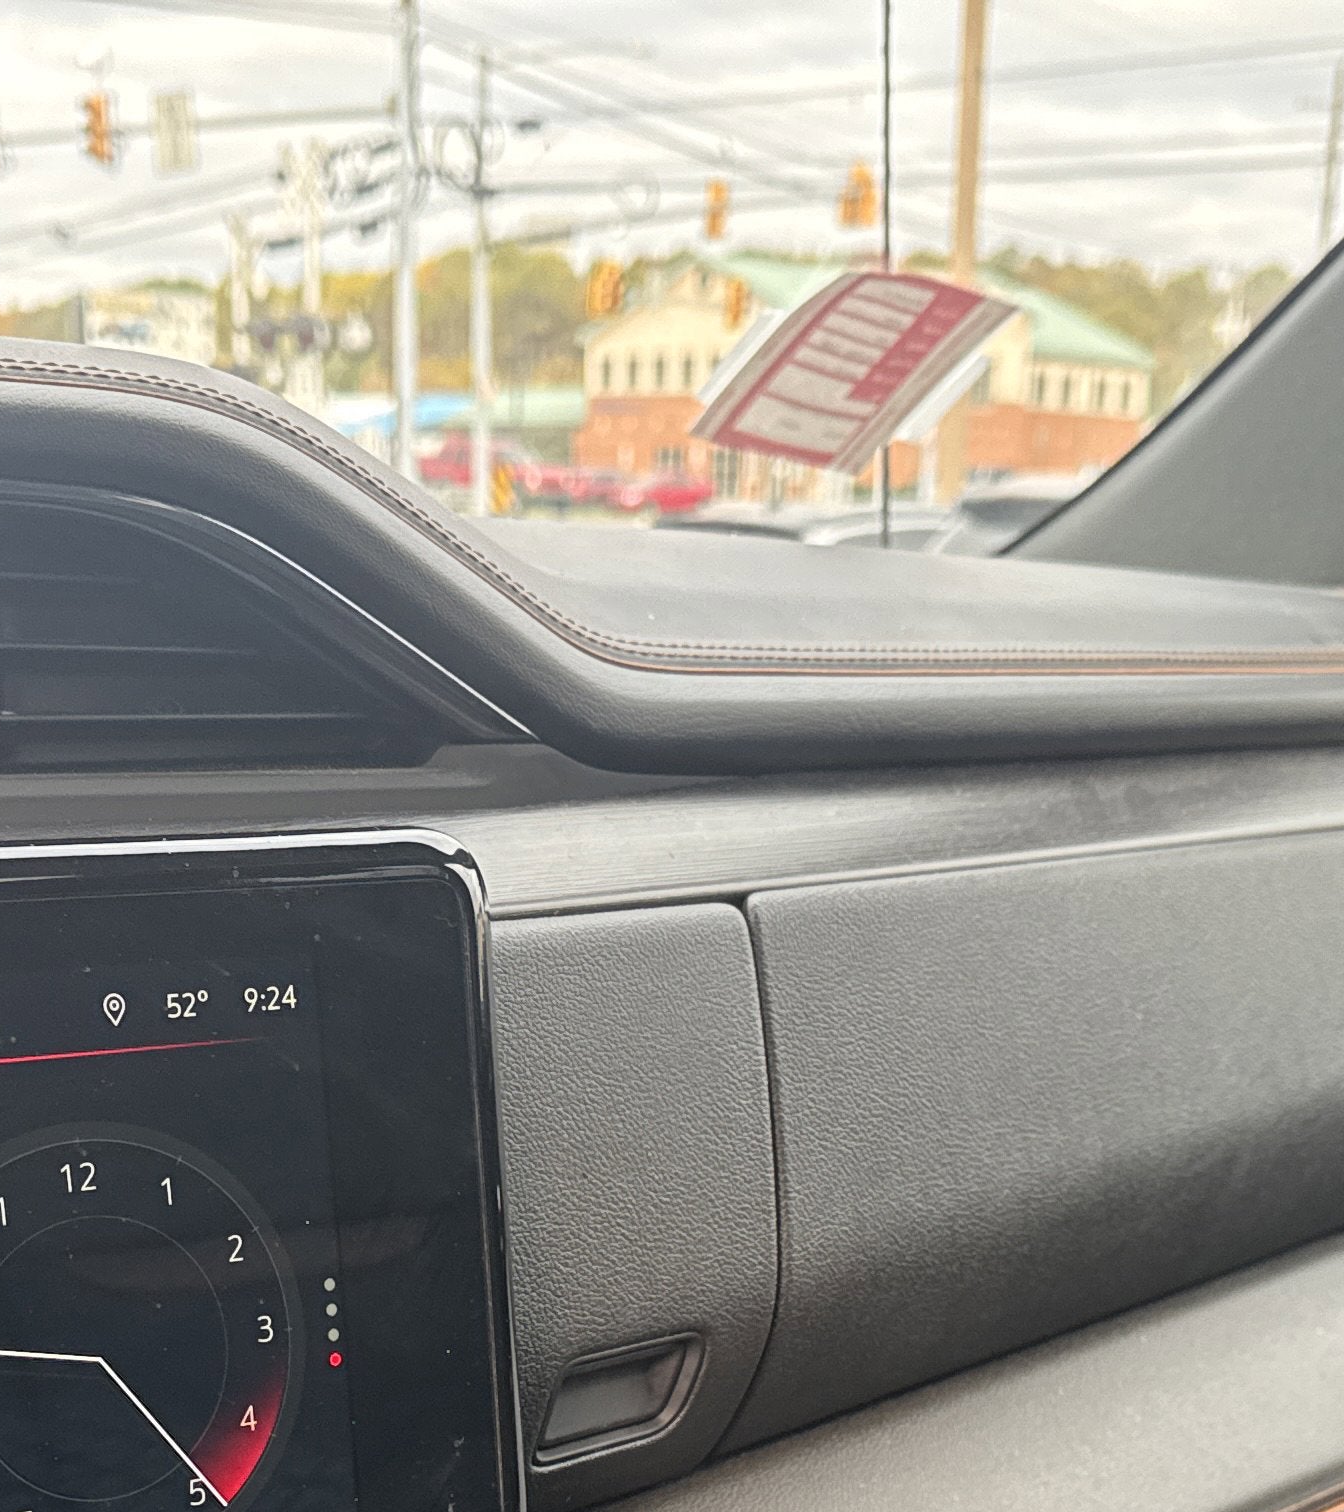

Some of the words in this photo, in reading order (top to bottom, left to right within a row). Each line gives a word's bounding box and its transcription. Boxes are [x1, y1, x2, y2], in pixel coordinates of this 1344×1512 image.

[244, 984, 297, 1013] 9:24
[60, 1161, 97, 1193] 12
[161, 1177, 173, 1206] 1
[227, 1234, 244, 1263] 2
[257, 1315, 274, 1343] 3
[240, 1404, 258, 1431] 4
[189, 1477, 206, 1506] 5
